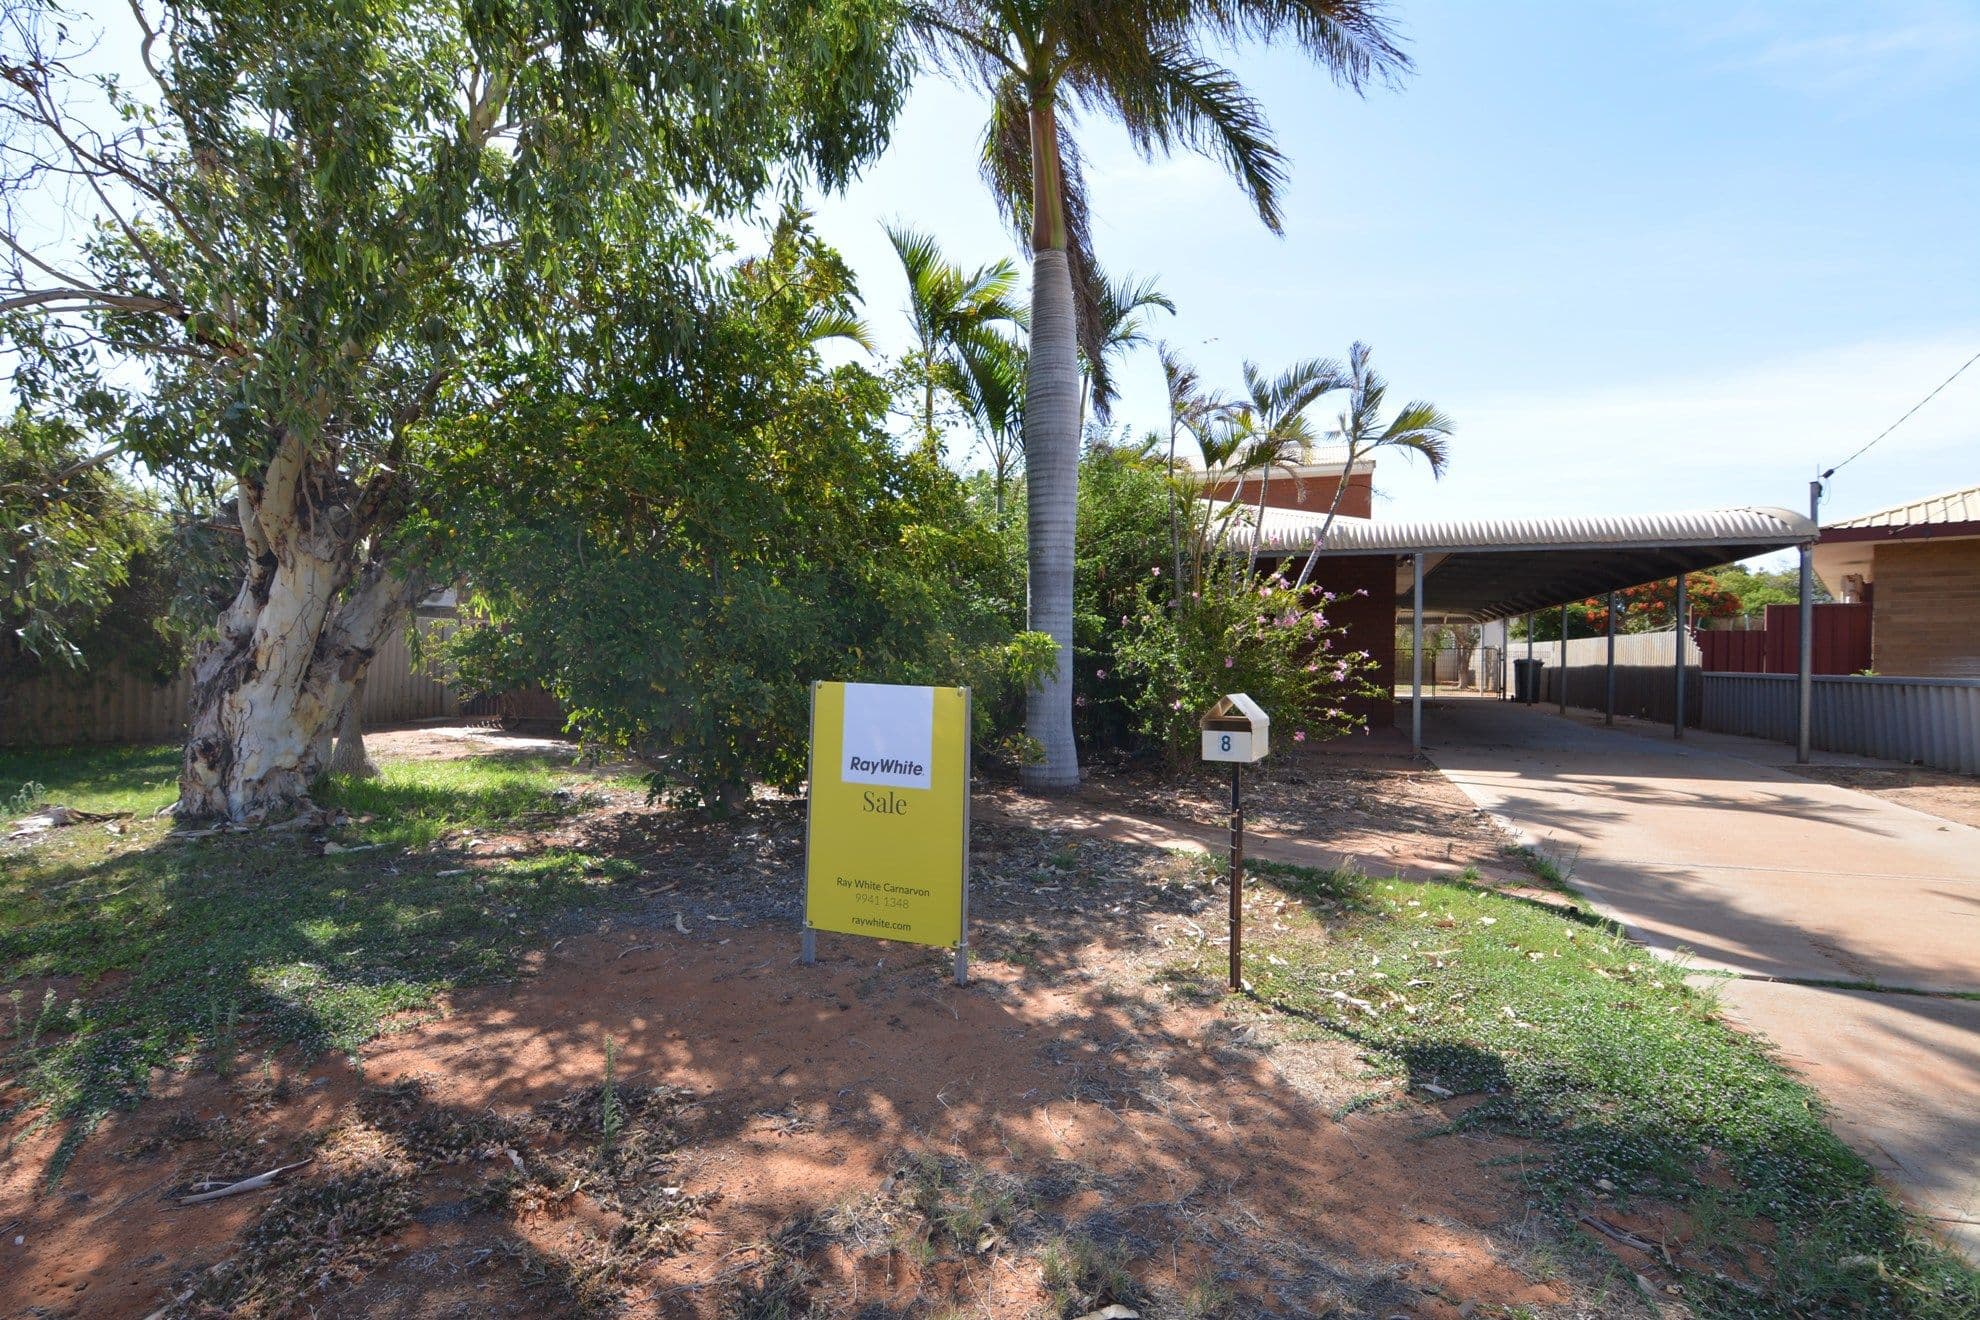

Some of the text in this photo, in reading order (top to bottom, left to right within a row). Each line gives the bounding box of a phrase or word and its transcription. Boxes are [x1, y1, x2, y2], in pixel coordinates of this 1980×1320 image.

[1221, 735, 1231, 752] 8
[863, 790, 908, 816] Sale
[836, 877, 930, 897] Ray White Carnarvon
[855, 893, 910, 909] 9941 1348
[851, 915, 911, 931] raywhite.com
